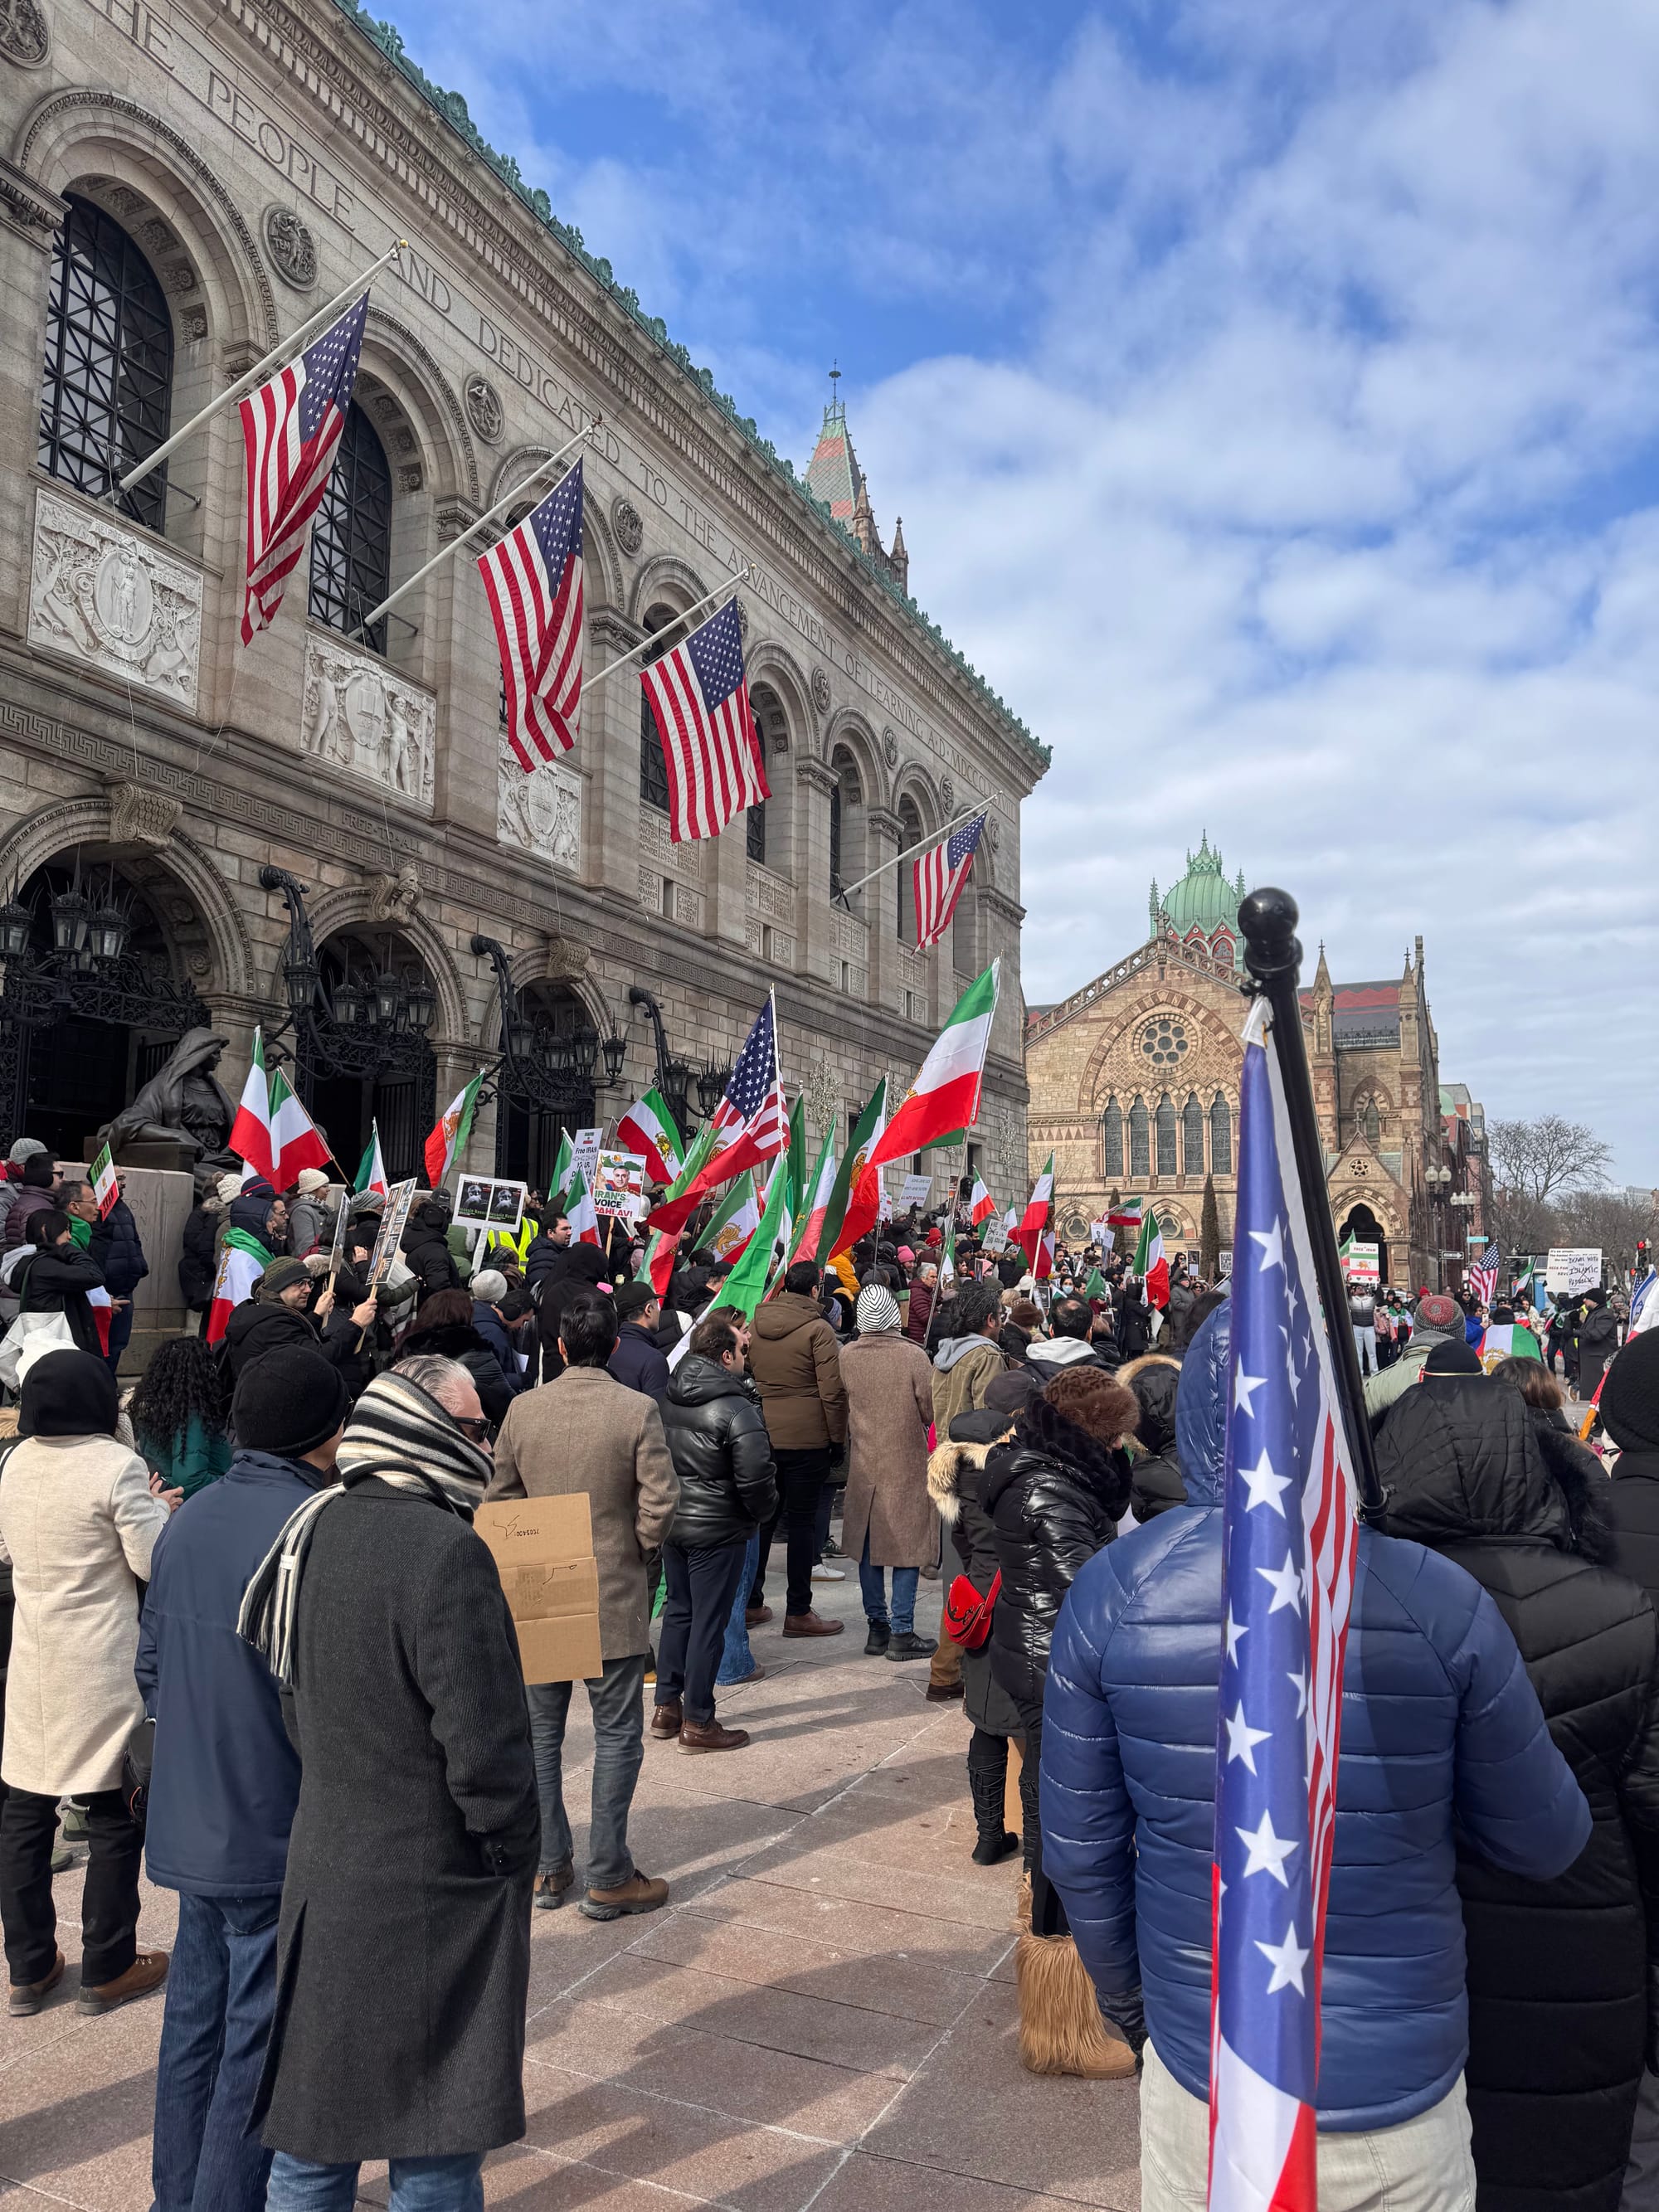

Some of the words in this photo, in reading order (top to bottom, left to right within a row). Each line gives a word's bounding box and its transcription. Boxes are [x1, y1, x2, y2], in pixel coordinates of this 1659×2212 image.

[105, 0, 175, 71] HE
[208, 69, 356, 232] PEOPLE
[387, 239, 452, 314] AND
[479, 317, 620, 464] DEDICATED
[639, 462, 667, 506] TO
[679, 498, 718, 555] THE
[727, 547, 837, 658] ADVANCEMENT
[845, 654, 863, 682] OF
[869, 673, 923, 739] LEARNING
[594, 1189, 626, 1202] IRAN'S
[594, 1198, 623, 1208] VOICE
[593, 1206, 634, 1218] PAHLAVI
